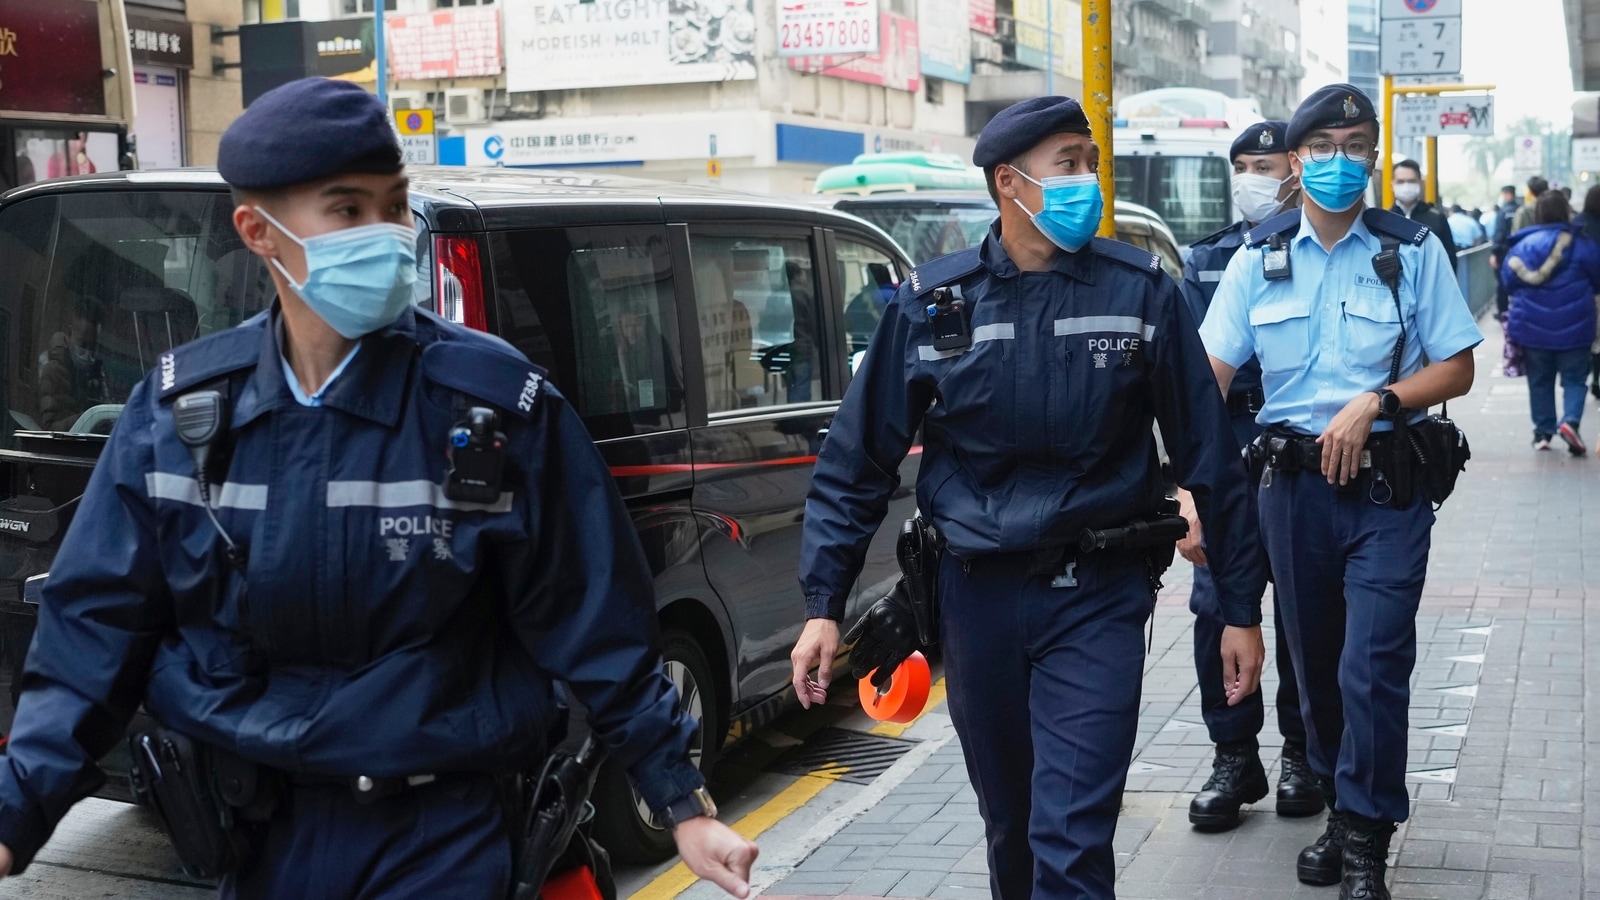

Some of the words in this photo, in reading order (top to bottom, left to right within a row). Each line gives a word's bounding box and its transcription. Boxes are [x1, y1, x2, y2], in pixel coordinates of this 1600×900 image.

[534, 4, 577, 25] EAT
[586, 0, 662, 22] RIGHT
[522, 34, 601, 52] MOREISH
[615, 30, 661, 46] MALT
[781, 19, 870, 49] 23457808
[1433, 22, 1445, 39] 7
[1432, 51, 1445, 69] 7
[909, 270, 922, 292] 28646
[1088, 337, 1140, 351] POLICE
[517, 371, 543, 412] 27384
[379, 515, 453, 538] POLICE
